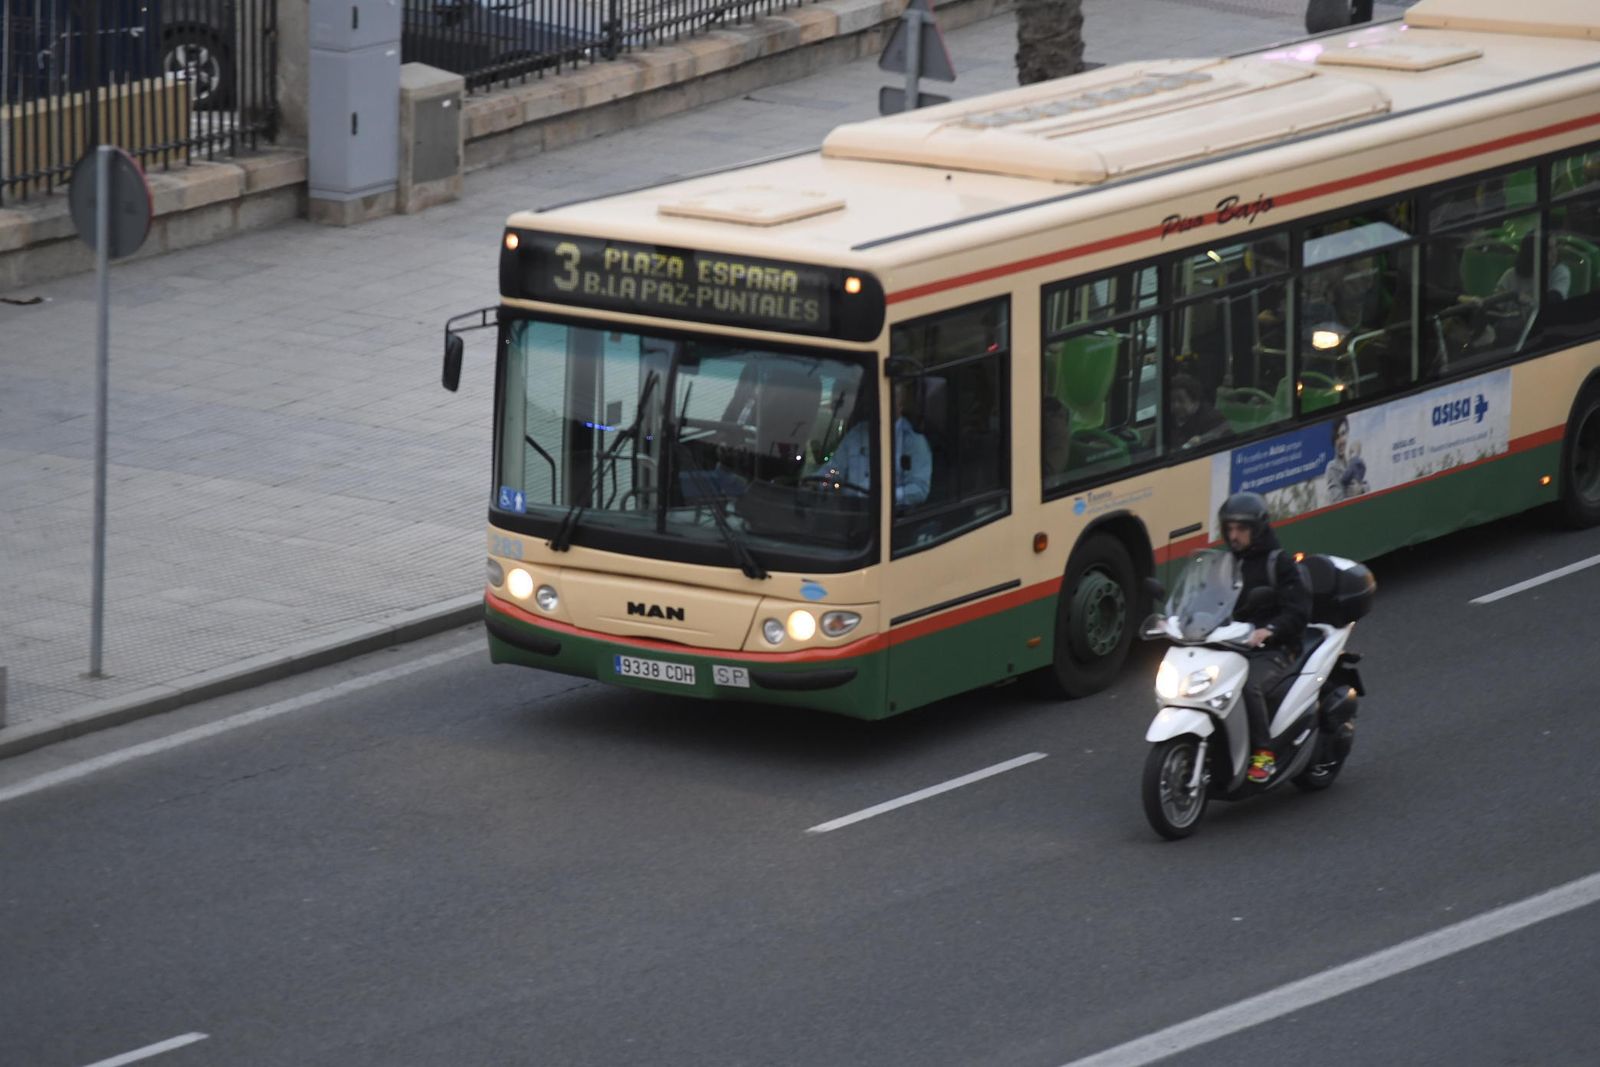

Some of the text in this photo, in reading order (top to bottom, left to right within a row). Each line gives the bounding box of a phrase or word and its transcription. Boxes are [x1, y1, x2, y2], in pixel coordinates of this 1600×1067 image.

[1215, 194, 1273, 226] Bajo
[553, 242, 581, 291] 3
[604, 247, 799, 294] PLAZA ESPAÑA
[1432, 397, 1471, 427] asisa
[627, 601, 685, 621] MAN
[622, 658, 694, 683] 9338 CDH
